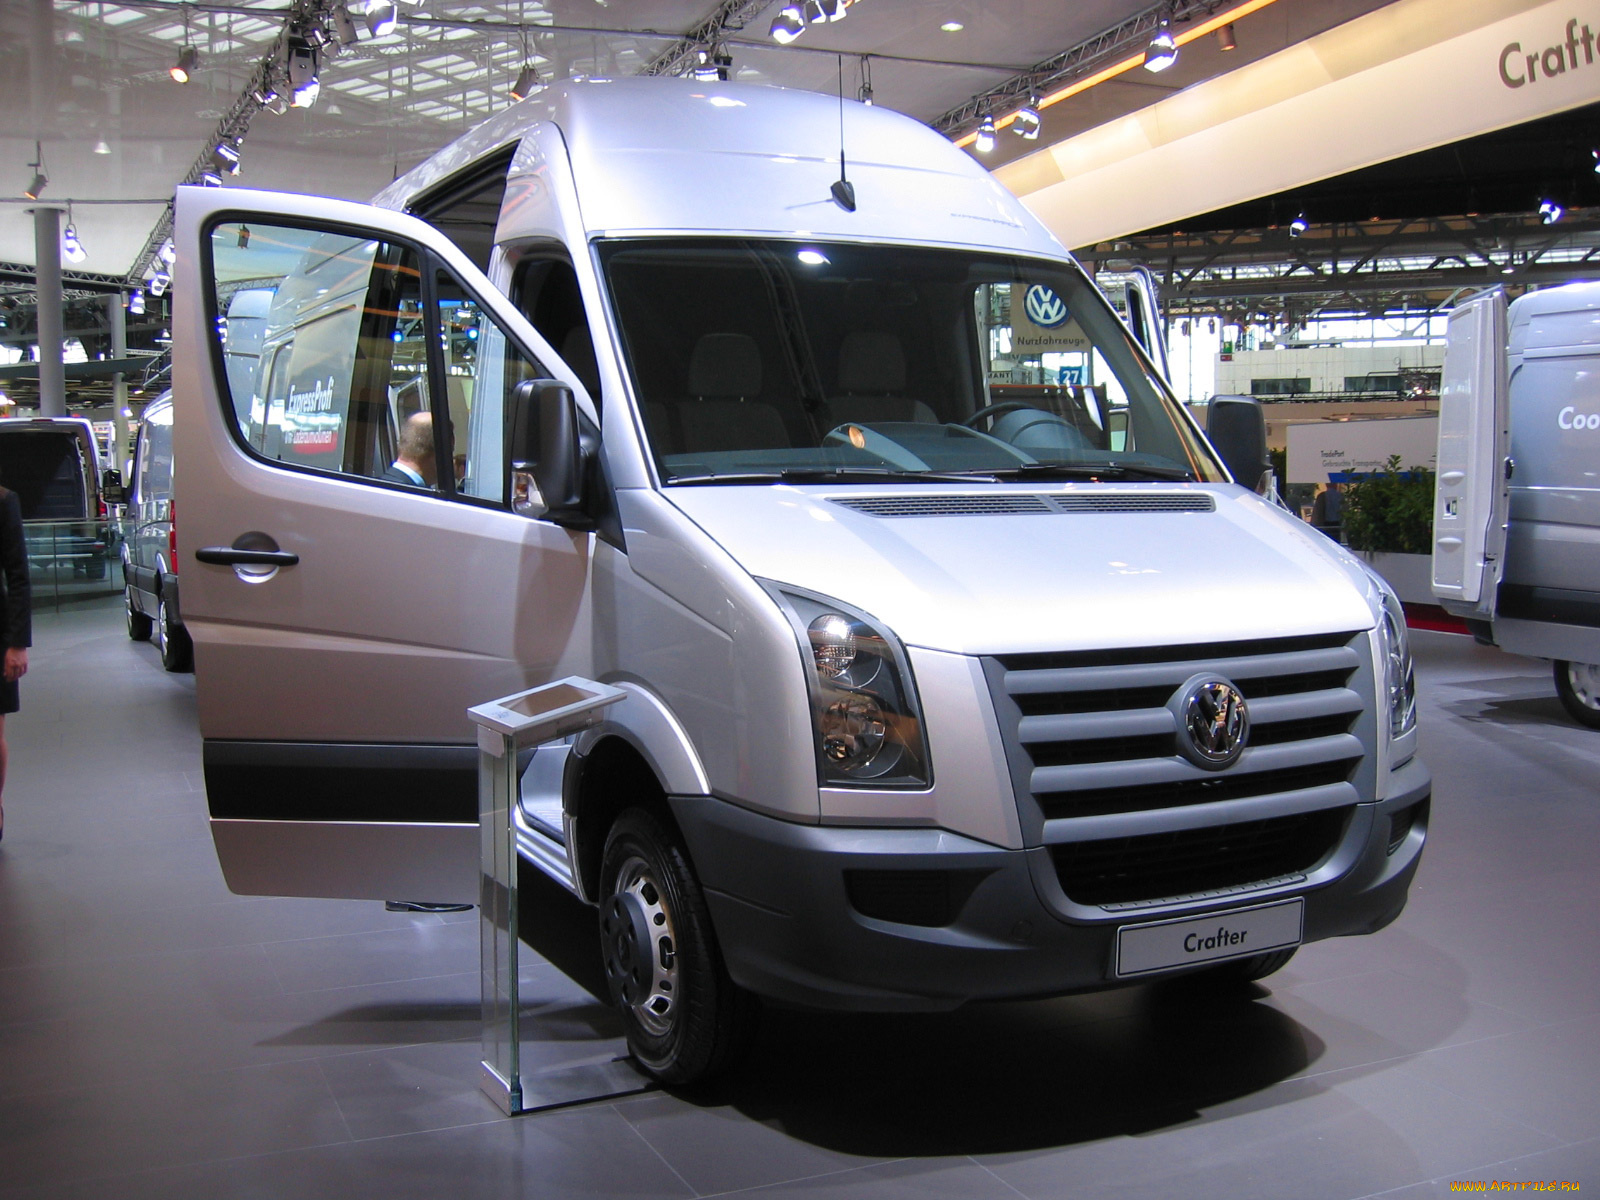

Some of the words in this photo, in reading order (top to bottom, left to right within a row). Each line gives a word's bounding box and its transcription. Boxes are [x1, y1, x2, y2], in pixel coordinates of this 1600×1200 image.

[1498, 18, 1600, 89] Craft
[1017, 335, 1085, 347] Nutzfahrzeuge
[1062, 370, 1080, 384] 27
[288, 375, 335, 413] ExpressProfi
[1558, 406, 1600, 430] Coo
[1183, 927, 1247, 953] Crafter
